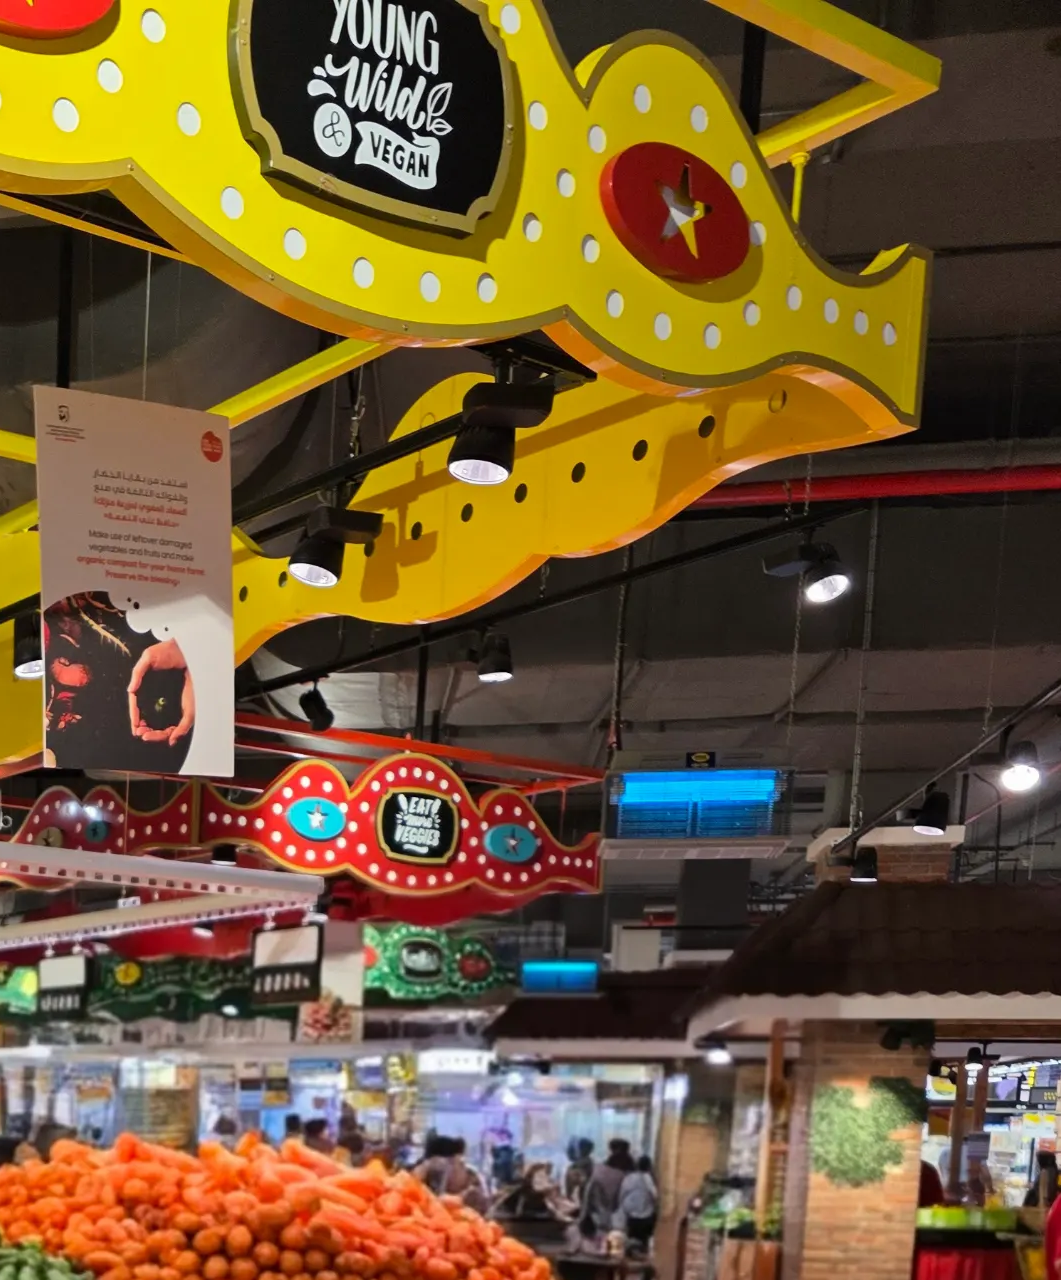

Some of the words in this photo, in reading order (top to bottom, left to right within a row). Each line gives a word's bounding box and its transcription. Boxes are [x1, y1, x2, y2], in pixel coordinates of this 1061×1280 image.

[329, 0, 439, 75] YOUNG
[324, 53, 427, 130] Wild
[369, 130, 430, 179] VEGAN
[88, 529, 109, 539] Make
[124, 533, 131, 541] of
[132, 534, 158, 544] leftover
[159, 538, 193, 550] damaged
[88, 544, 127, 554] vegetables
[128, 547, 143, 556] and
[144, 548, 160, 558] fruits
[161, 551, 175, 560] and
[175, 553, 194, 562] make
[138, 560, 149, 569] for
[150, 563, 166, 571] your
[137, 573, 149, 582] the
[408, 796, 434, 815] EAT
[394, 824, 440, 847] VEGGIES
